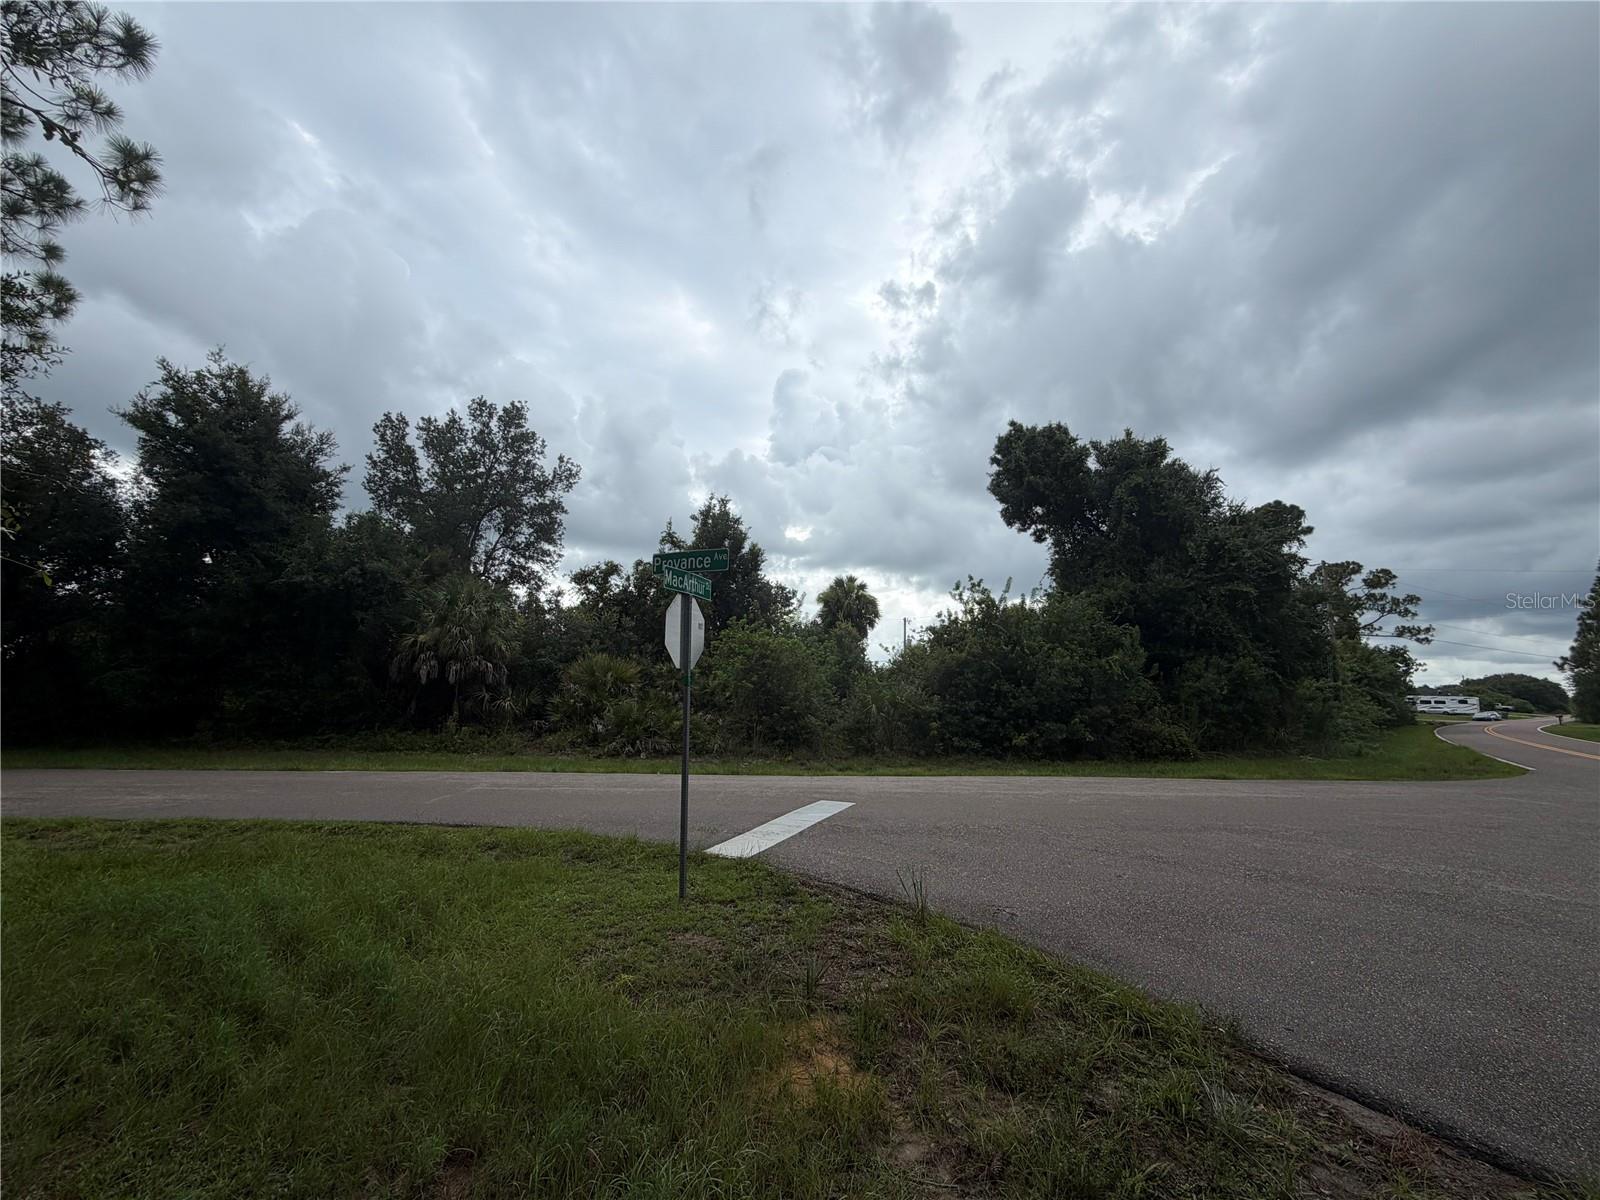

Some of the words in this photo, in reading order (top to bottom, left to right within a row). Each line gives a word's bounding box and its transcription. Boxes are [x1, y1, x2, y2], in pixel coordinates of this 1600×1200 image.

[654, 556, 711, 572] Provance
[714, 552, 728, 561] Ave
[665, 568, 705, 595] MacArthur
